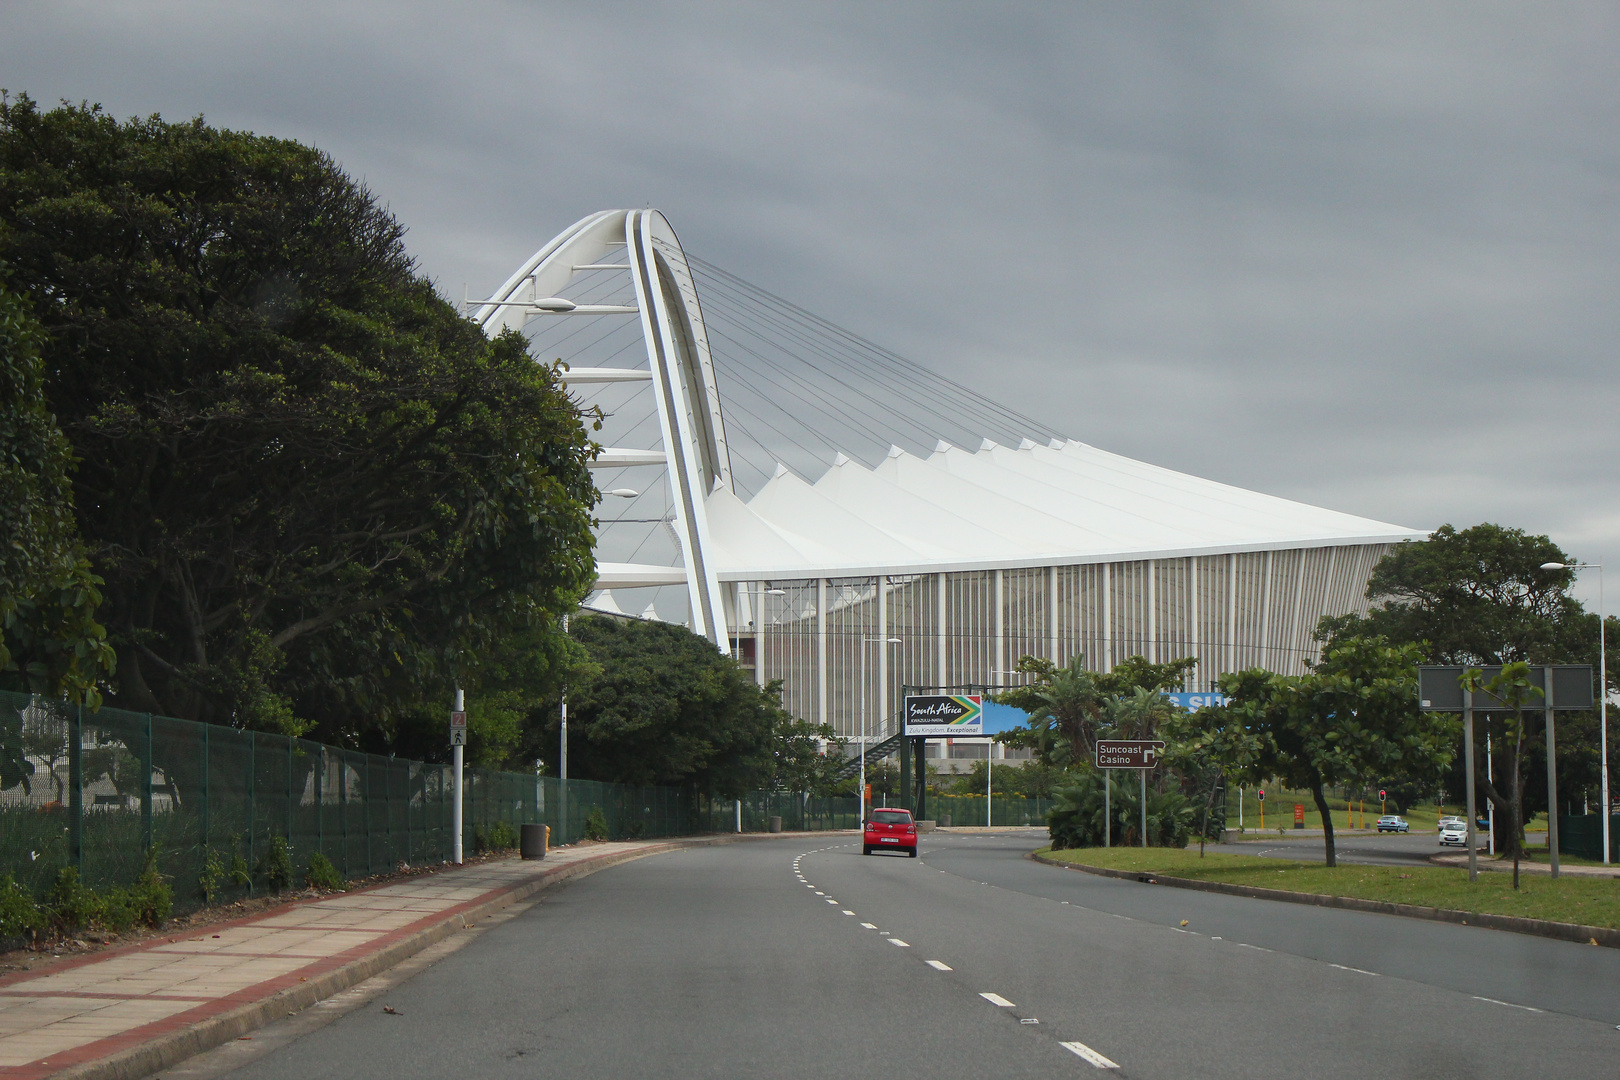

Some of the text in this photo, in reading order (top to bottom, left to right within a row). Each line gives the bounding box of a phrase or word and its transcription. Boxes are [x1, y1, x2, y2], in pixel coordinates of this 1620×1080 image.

[910, 702, 962, 717] South Africa
[455, 714, 462, 725] 2
[1100, 745, 1142, 754] Suncoast
[1100, 755, 1131, 764] Casino
